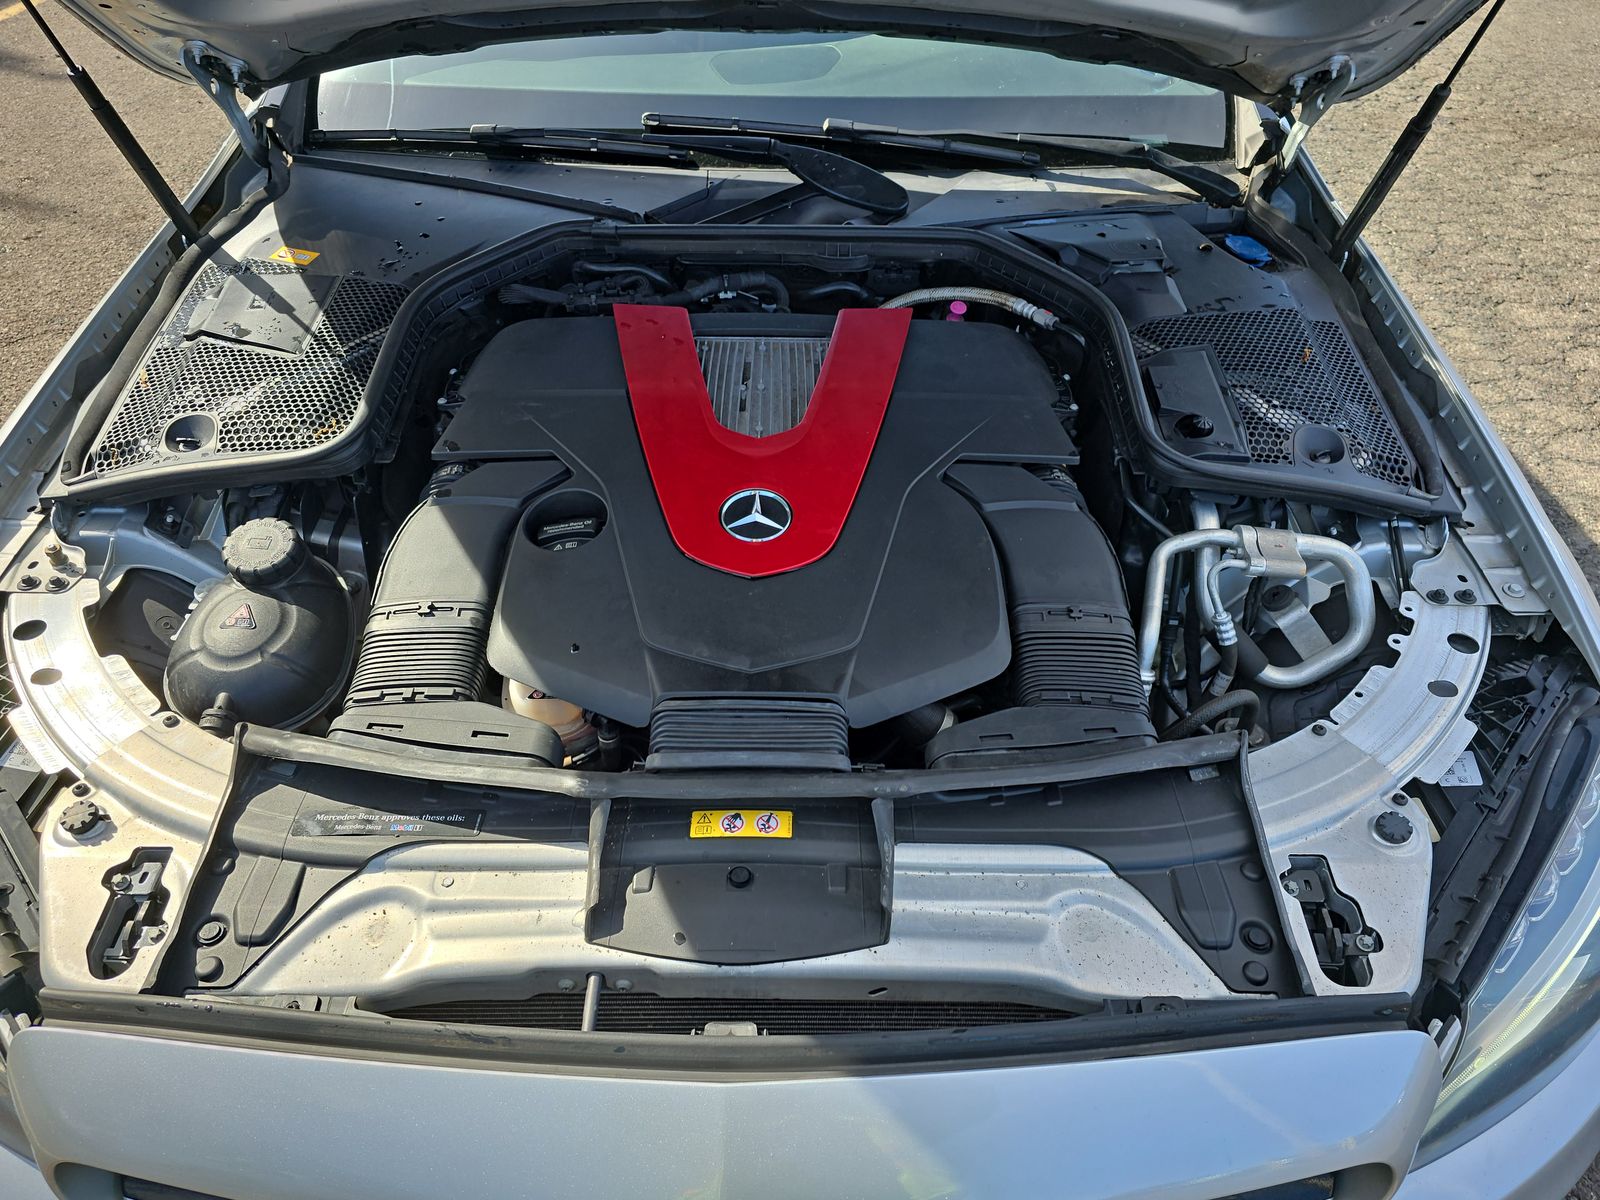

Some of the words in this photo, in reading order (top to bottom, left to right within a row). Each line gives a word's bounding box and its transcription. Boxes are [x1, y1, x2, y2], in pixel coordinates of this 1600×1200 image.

[315, 812, 380, 821] Mercedes-Benz
[381, 814, 420, 822] approves
[422, 814, 445, 822] these
[446, 814, 465, 822] oils:
